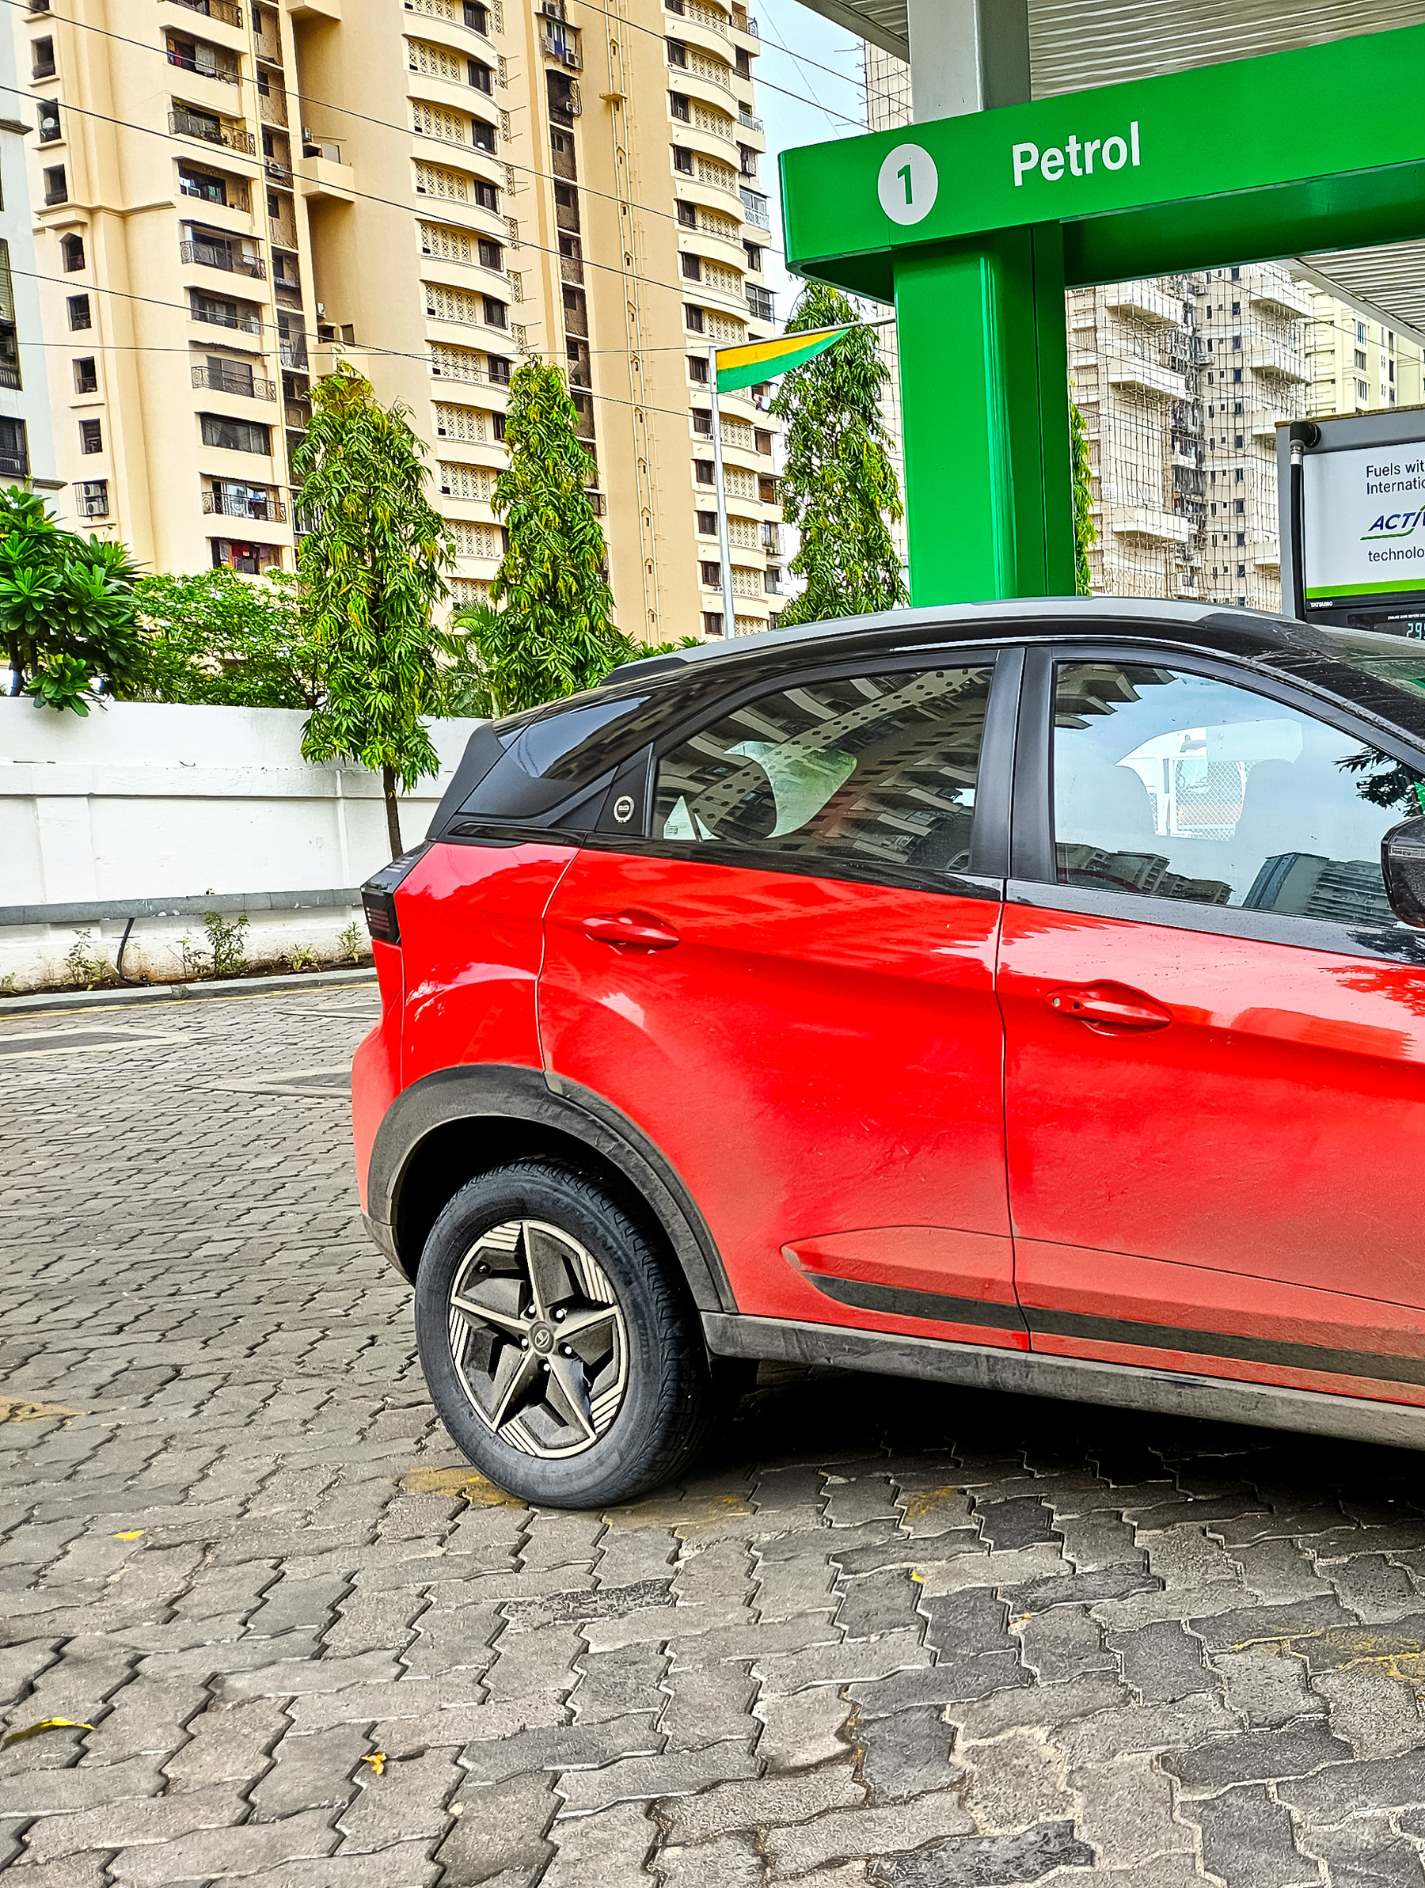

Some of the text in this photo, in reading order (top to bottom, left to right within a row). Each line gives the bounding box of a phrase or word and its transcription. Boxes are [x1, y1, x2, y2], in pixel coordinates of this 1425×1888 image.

[896, 163, 914, 205] 1
[1011, 120, 1142, 188] Petrol
[1365, 462, 1401, 478] Fuels
